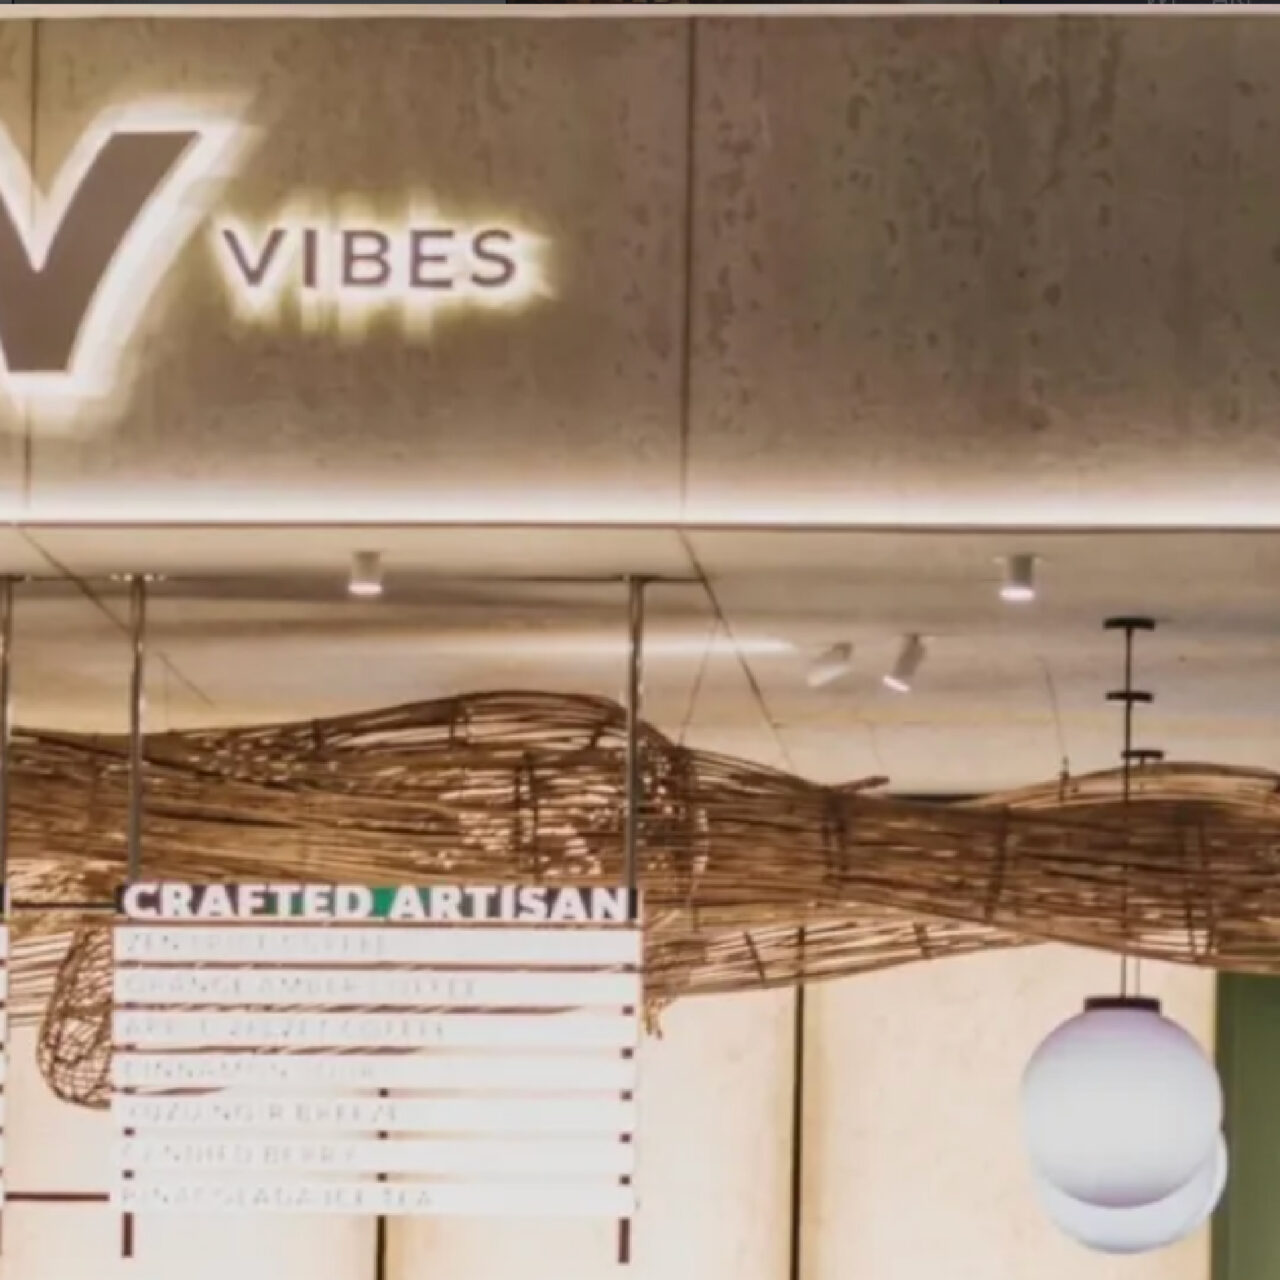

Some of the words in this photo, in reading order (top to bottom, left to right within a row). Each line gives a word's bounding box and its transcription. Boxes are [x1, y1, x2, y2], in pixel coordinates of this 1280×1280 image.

[222, 228, 516, 289] VIBES
[122, 884, 376, 919] CRAFTED
[388, 885, 632, 921] ARTISAN
